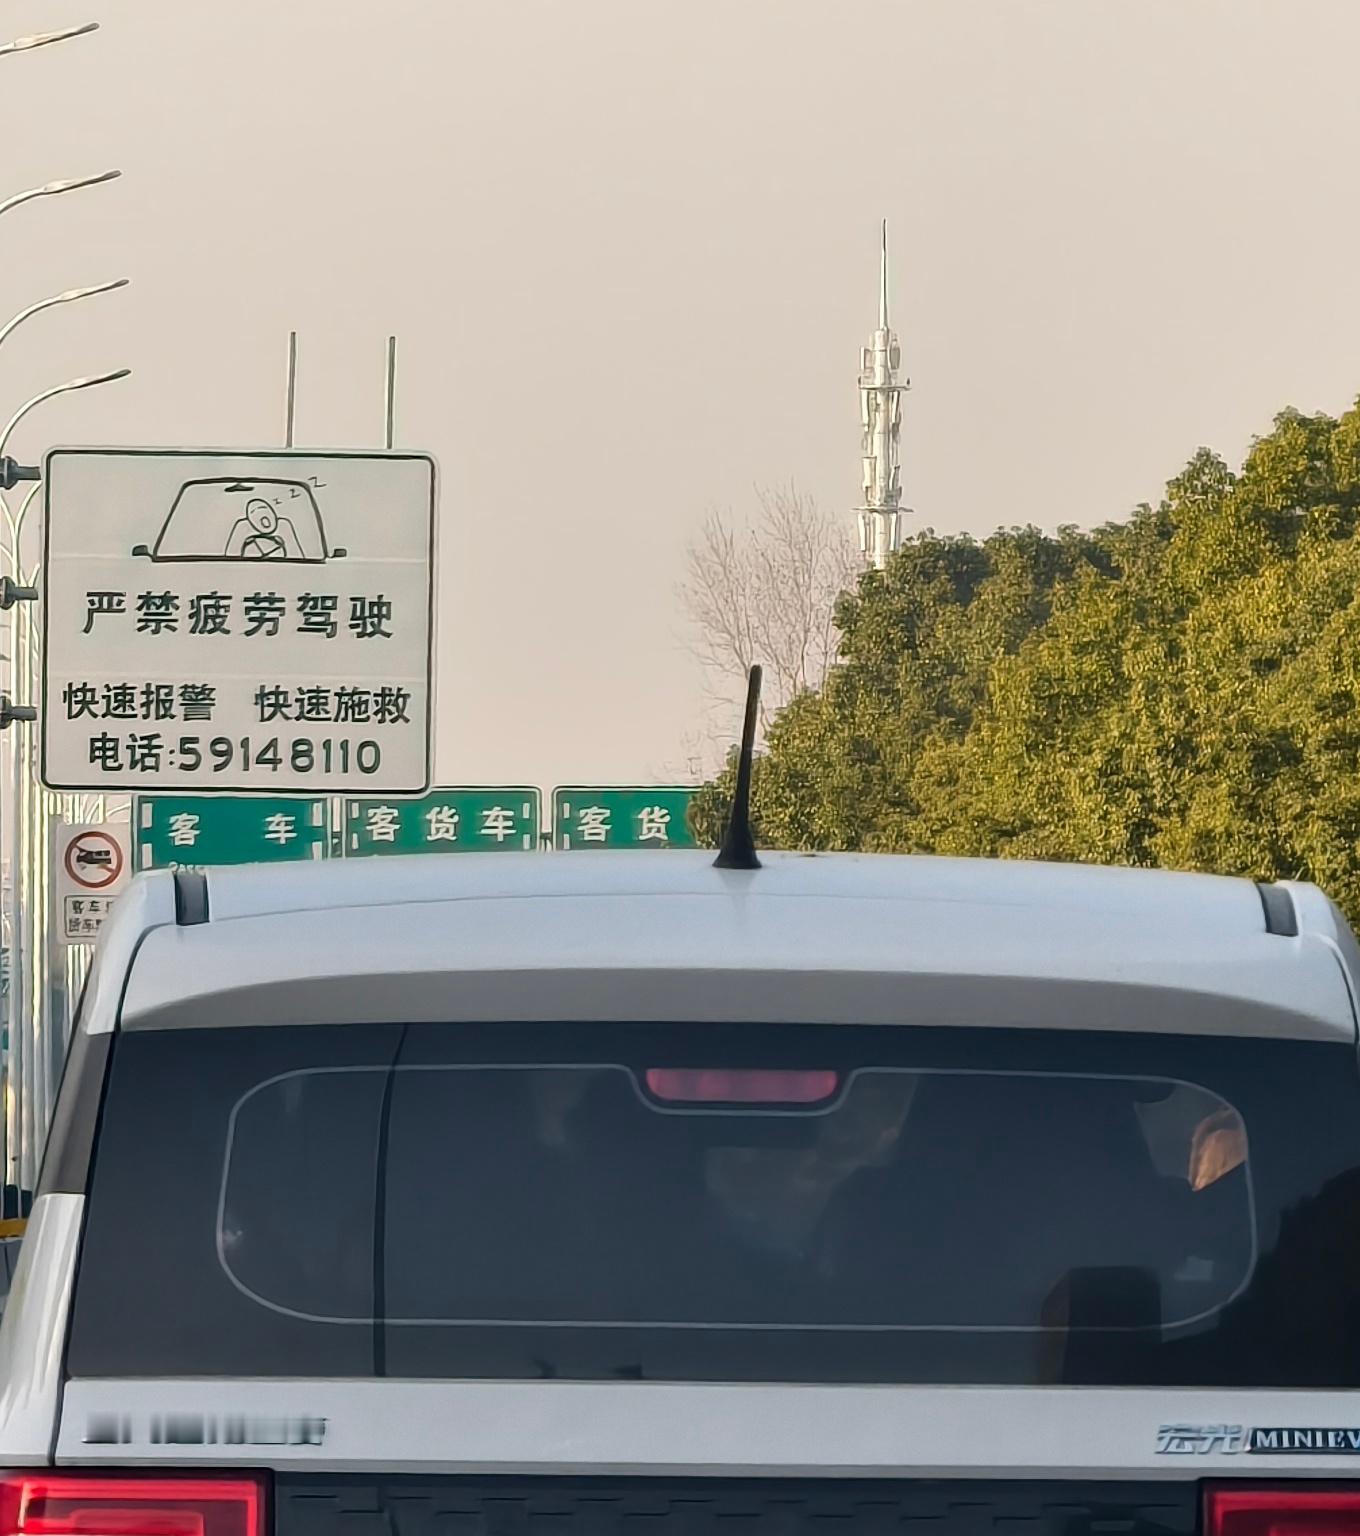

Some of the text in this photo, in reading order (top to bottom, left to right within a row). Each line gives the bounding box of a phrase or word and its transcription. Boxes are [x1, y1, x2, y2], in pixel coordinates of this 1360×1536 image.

[82, 591, 393, 639] 严禁疲劳驾驶
[62, 683, 411, 724] 快速报警 快速施救
[89, 732, 381, 775] 电话:59148110
[366, 805, 516, 842] 客货车
